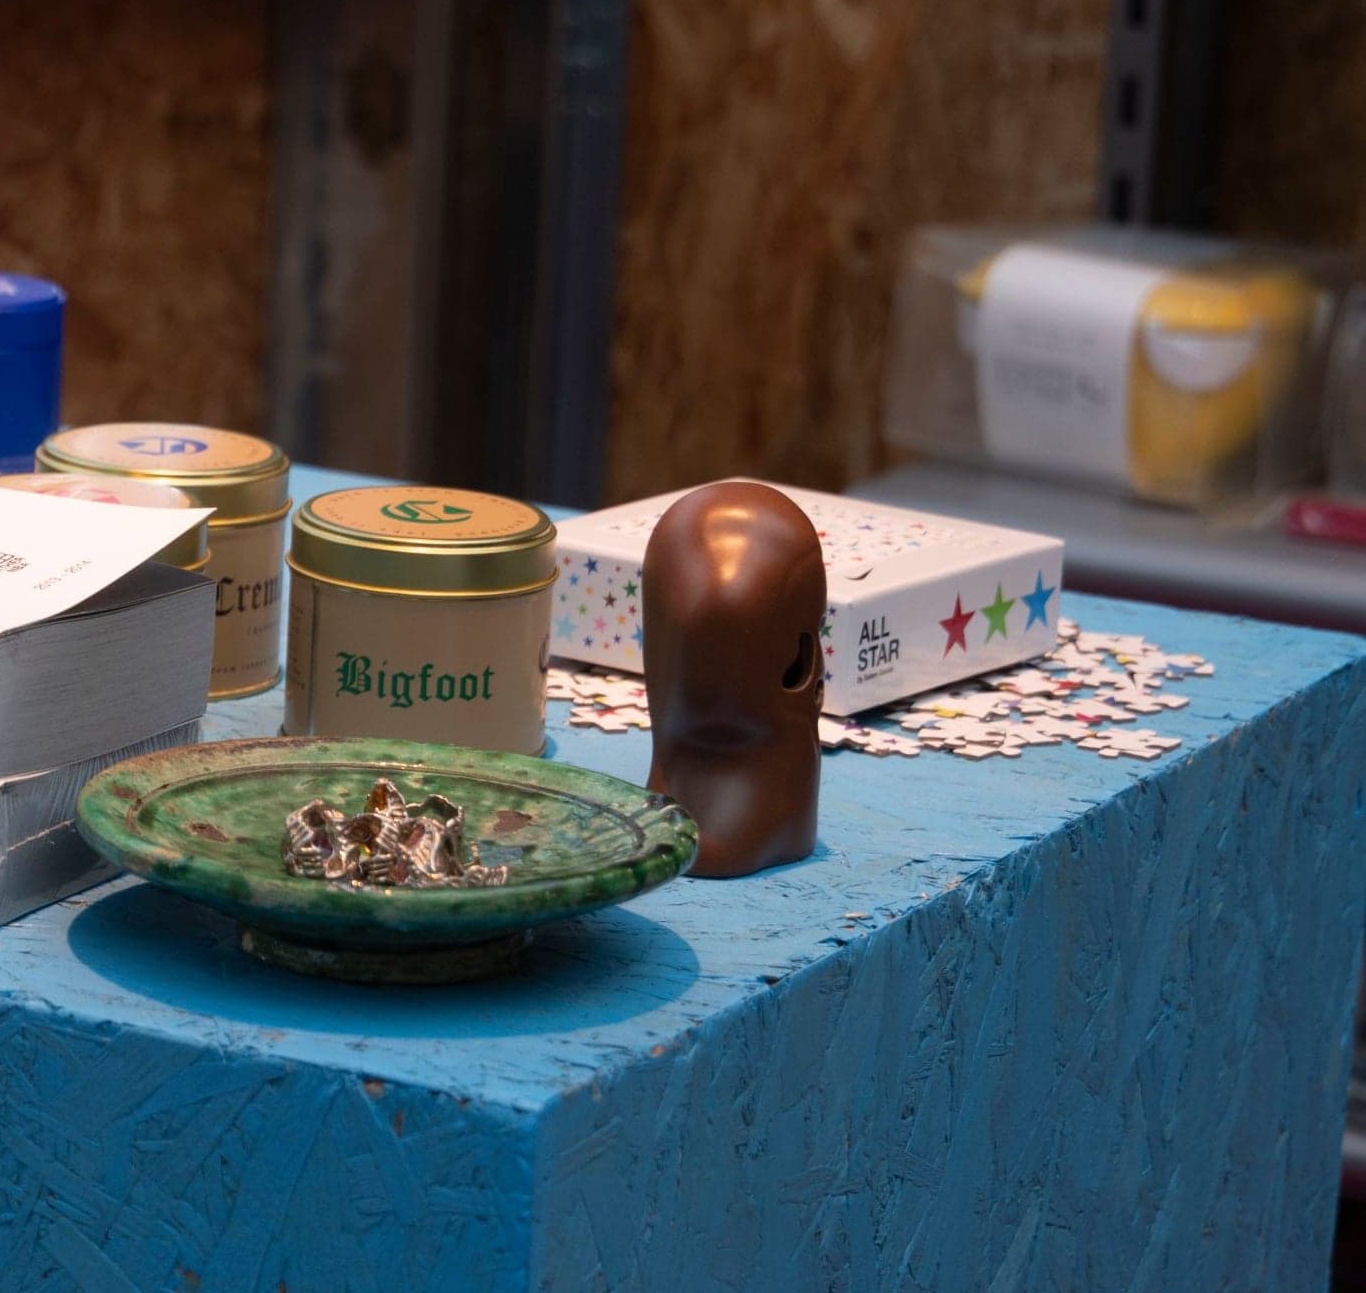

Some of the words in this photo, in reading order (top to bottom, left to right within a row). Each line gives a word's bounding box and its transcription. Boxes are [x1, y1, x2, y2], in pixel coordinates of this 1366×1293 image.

[859, 615, 890, 646] ALL
[857, 638, 901, 672] STAR
[336, 651, 496, 709] Bigfoot
